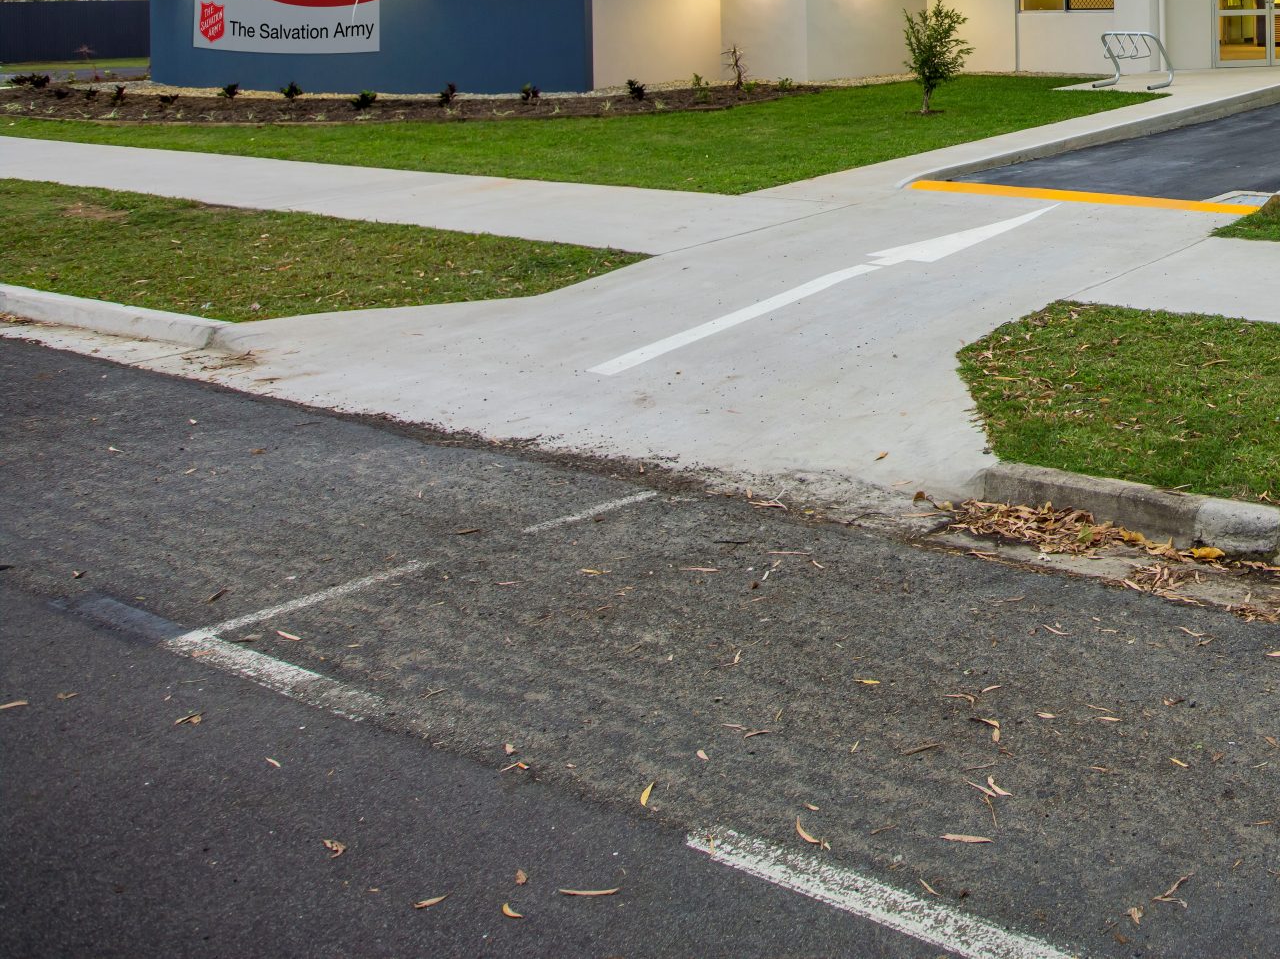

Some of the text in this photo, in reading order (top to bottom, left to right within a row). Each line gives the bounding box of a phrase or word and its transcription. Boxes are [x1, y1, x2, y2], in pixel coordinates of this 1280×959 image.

[204, 6, 214, 17] THE
[207, 23, 222, 38] ARMY
[229, 20, 374, 39] The Salvation Army
